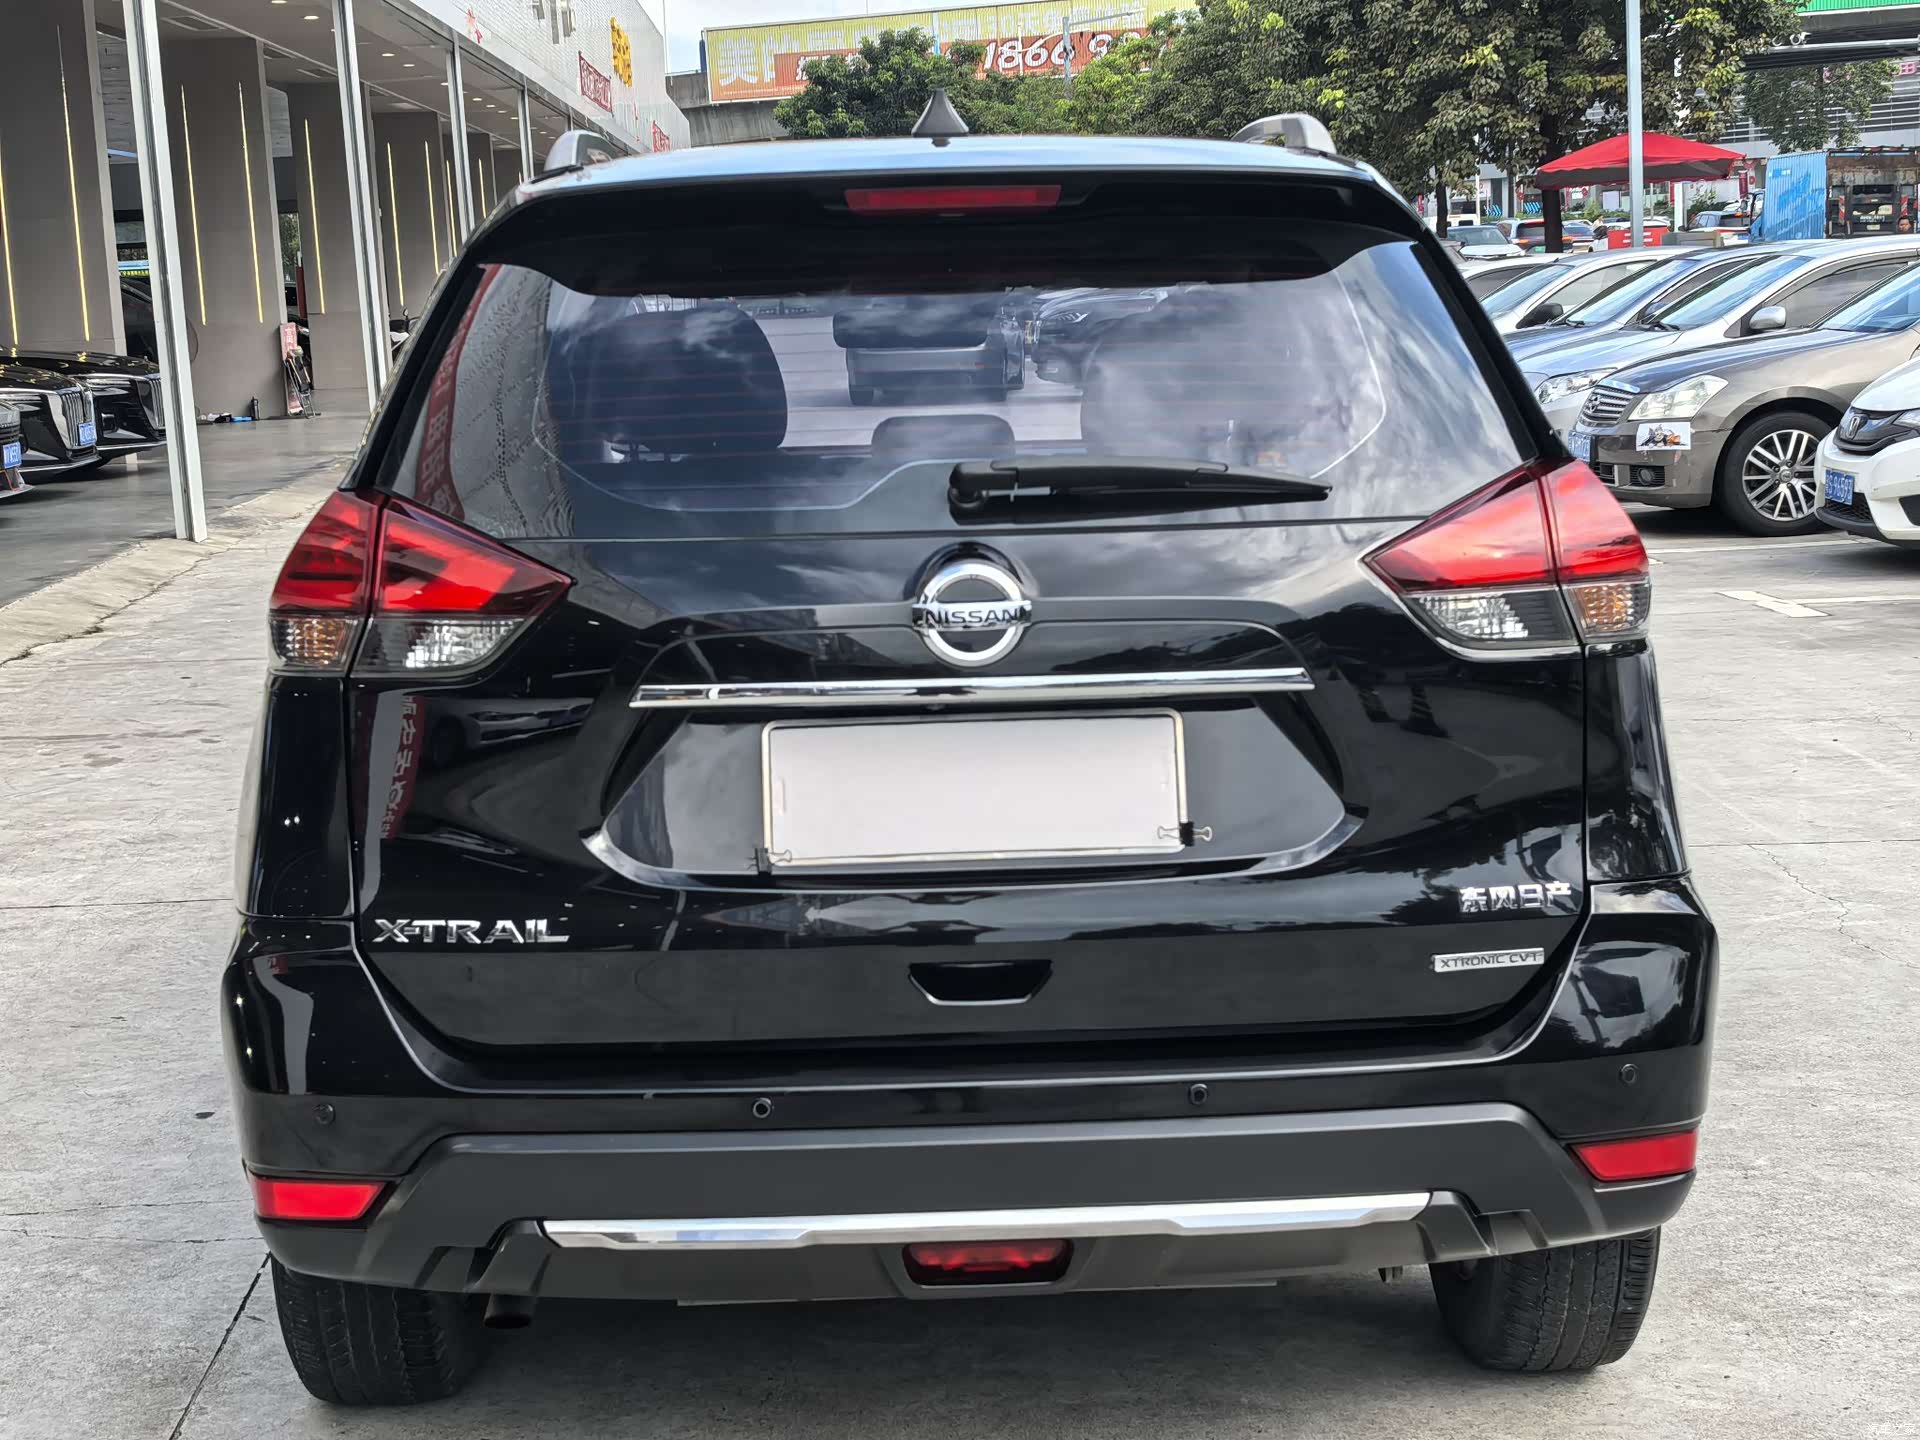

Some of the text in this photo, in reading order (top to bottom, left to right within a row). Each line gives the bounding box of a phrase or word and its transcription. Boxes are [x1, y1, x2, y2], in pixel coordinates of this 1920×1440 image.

[924, 608, 1018, 625] NISSAN
[1459, 881, 1571, 912] 东风日产
[372, 919, 570, 944] X-TRAIL
[1440, 952, 1543, 969] XTRONIC CVT
